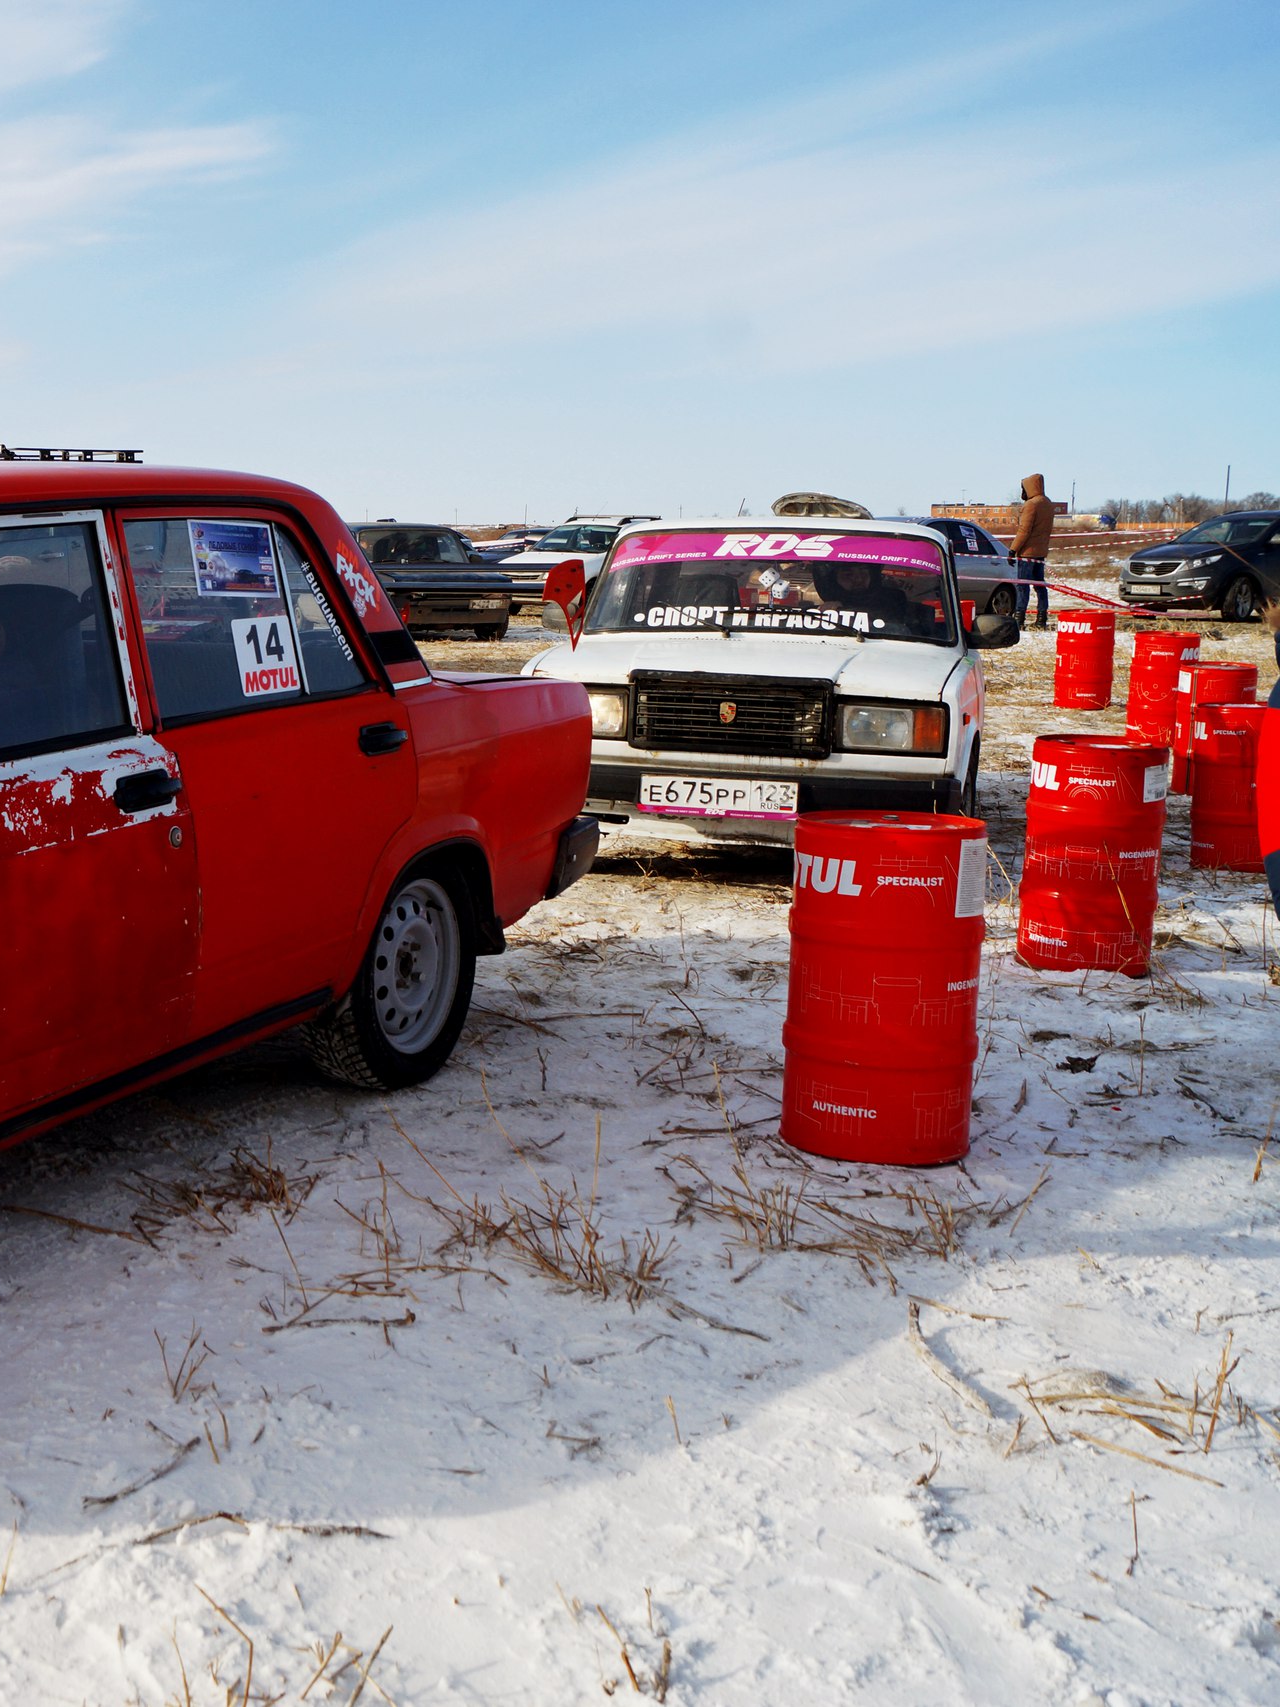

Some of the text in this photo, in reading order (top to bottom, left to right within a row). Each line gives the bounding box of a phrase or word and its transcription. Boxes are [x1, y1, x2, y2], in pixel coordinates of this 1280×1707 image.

[713, 533, 846, 558] RDS
[610, 551, 707, 569] RUSSIAN DRIFT SERIES
[837, 552, 942, 572] RUSSIAN DRIFT SERIES
[245, 622, 285, 666] 14
[244, 666, 298, 694] MOTUL
[1068, 776, 1117, 788] SPECIALIST
[754, 784, 792, 804] 123
[760, 802, 779, 811] RUS
[794, 850, 945, 897] TUL SPECIALIST
[1028, 932, 1068, 948] AUTHENTIC
[812, 1100, 878, 1119] AUTHENTIC
